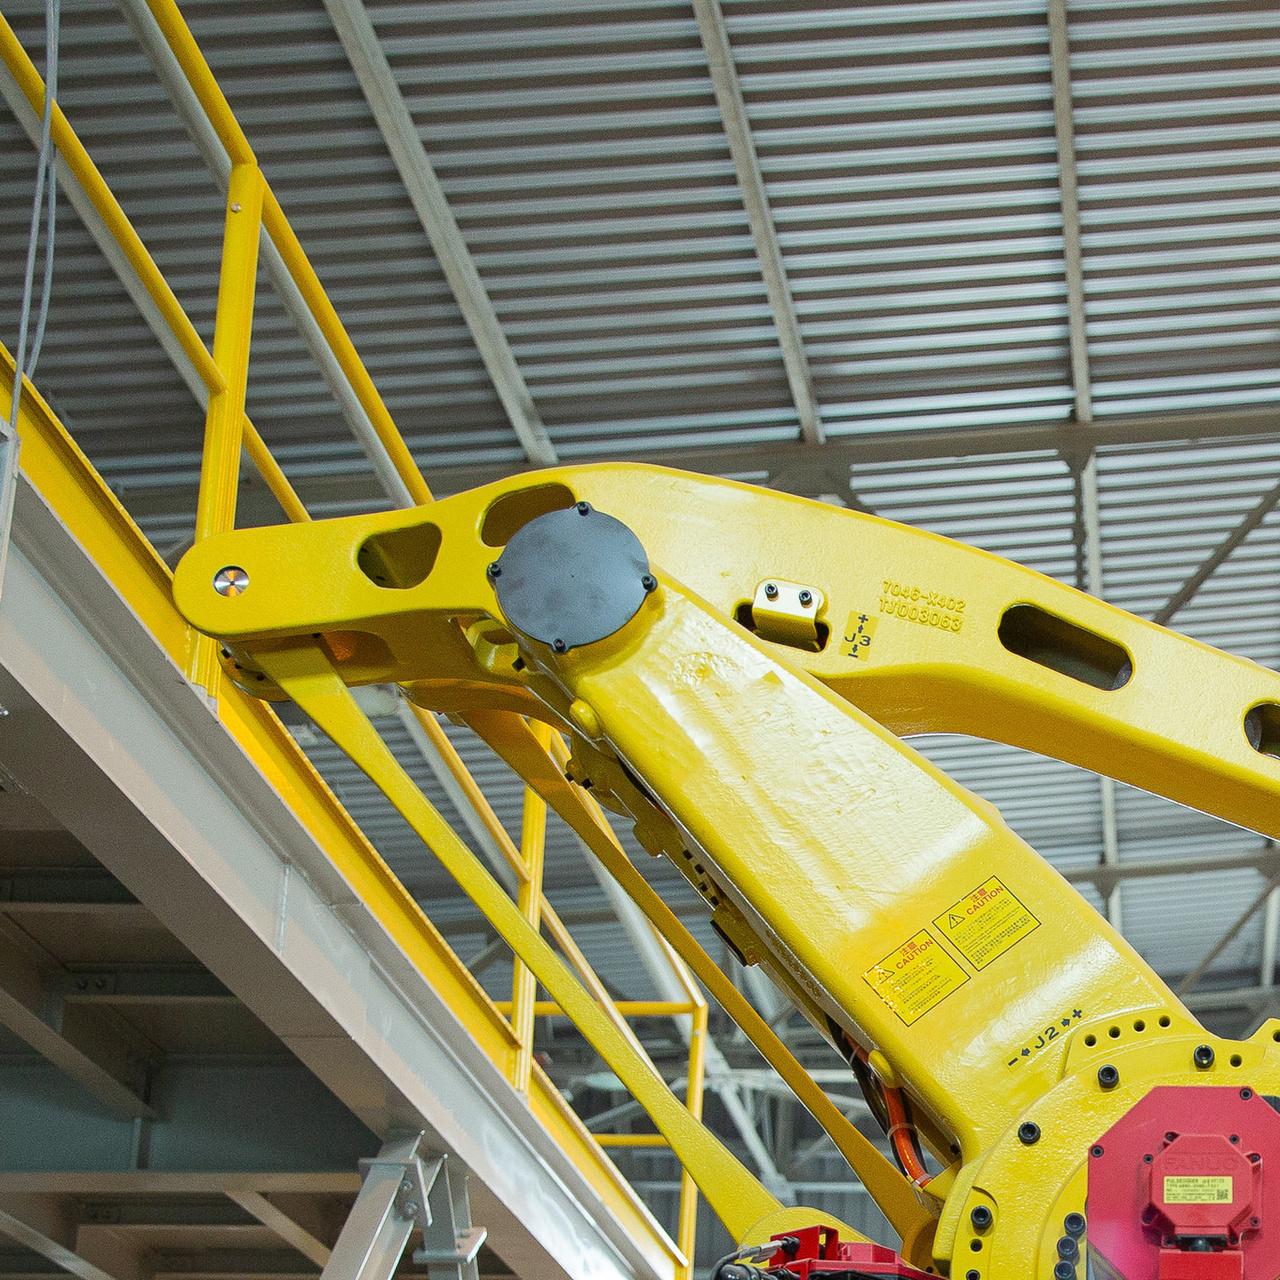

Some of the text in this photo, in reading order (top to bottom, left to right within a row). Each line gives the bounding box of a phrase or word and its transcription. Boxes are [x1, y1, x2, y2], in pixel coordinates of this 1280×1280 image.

[883, 580, 966, 613] 7046-X402
[966, 885, 1004, 915] CAUTION
[896, 938, 934, 969] CAUTION
[1034, 1026, 1060, 1049] J2
